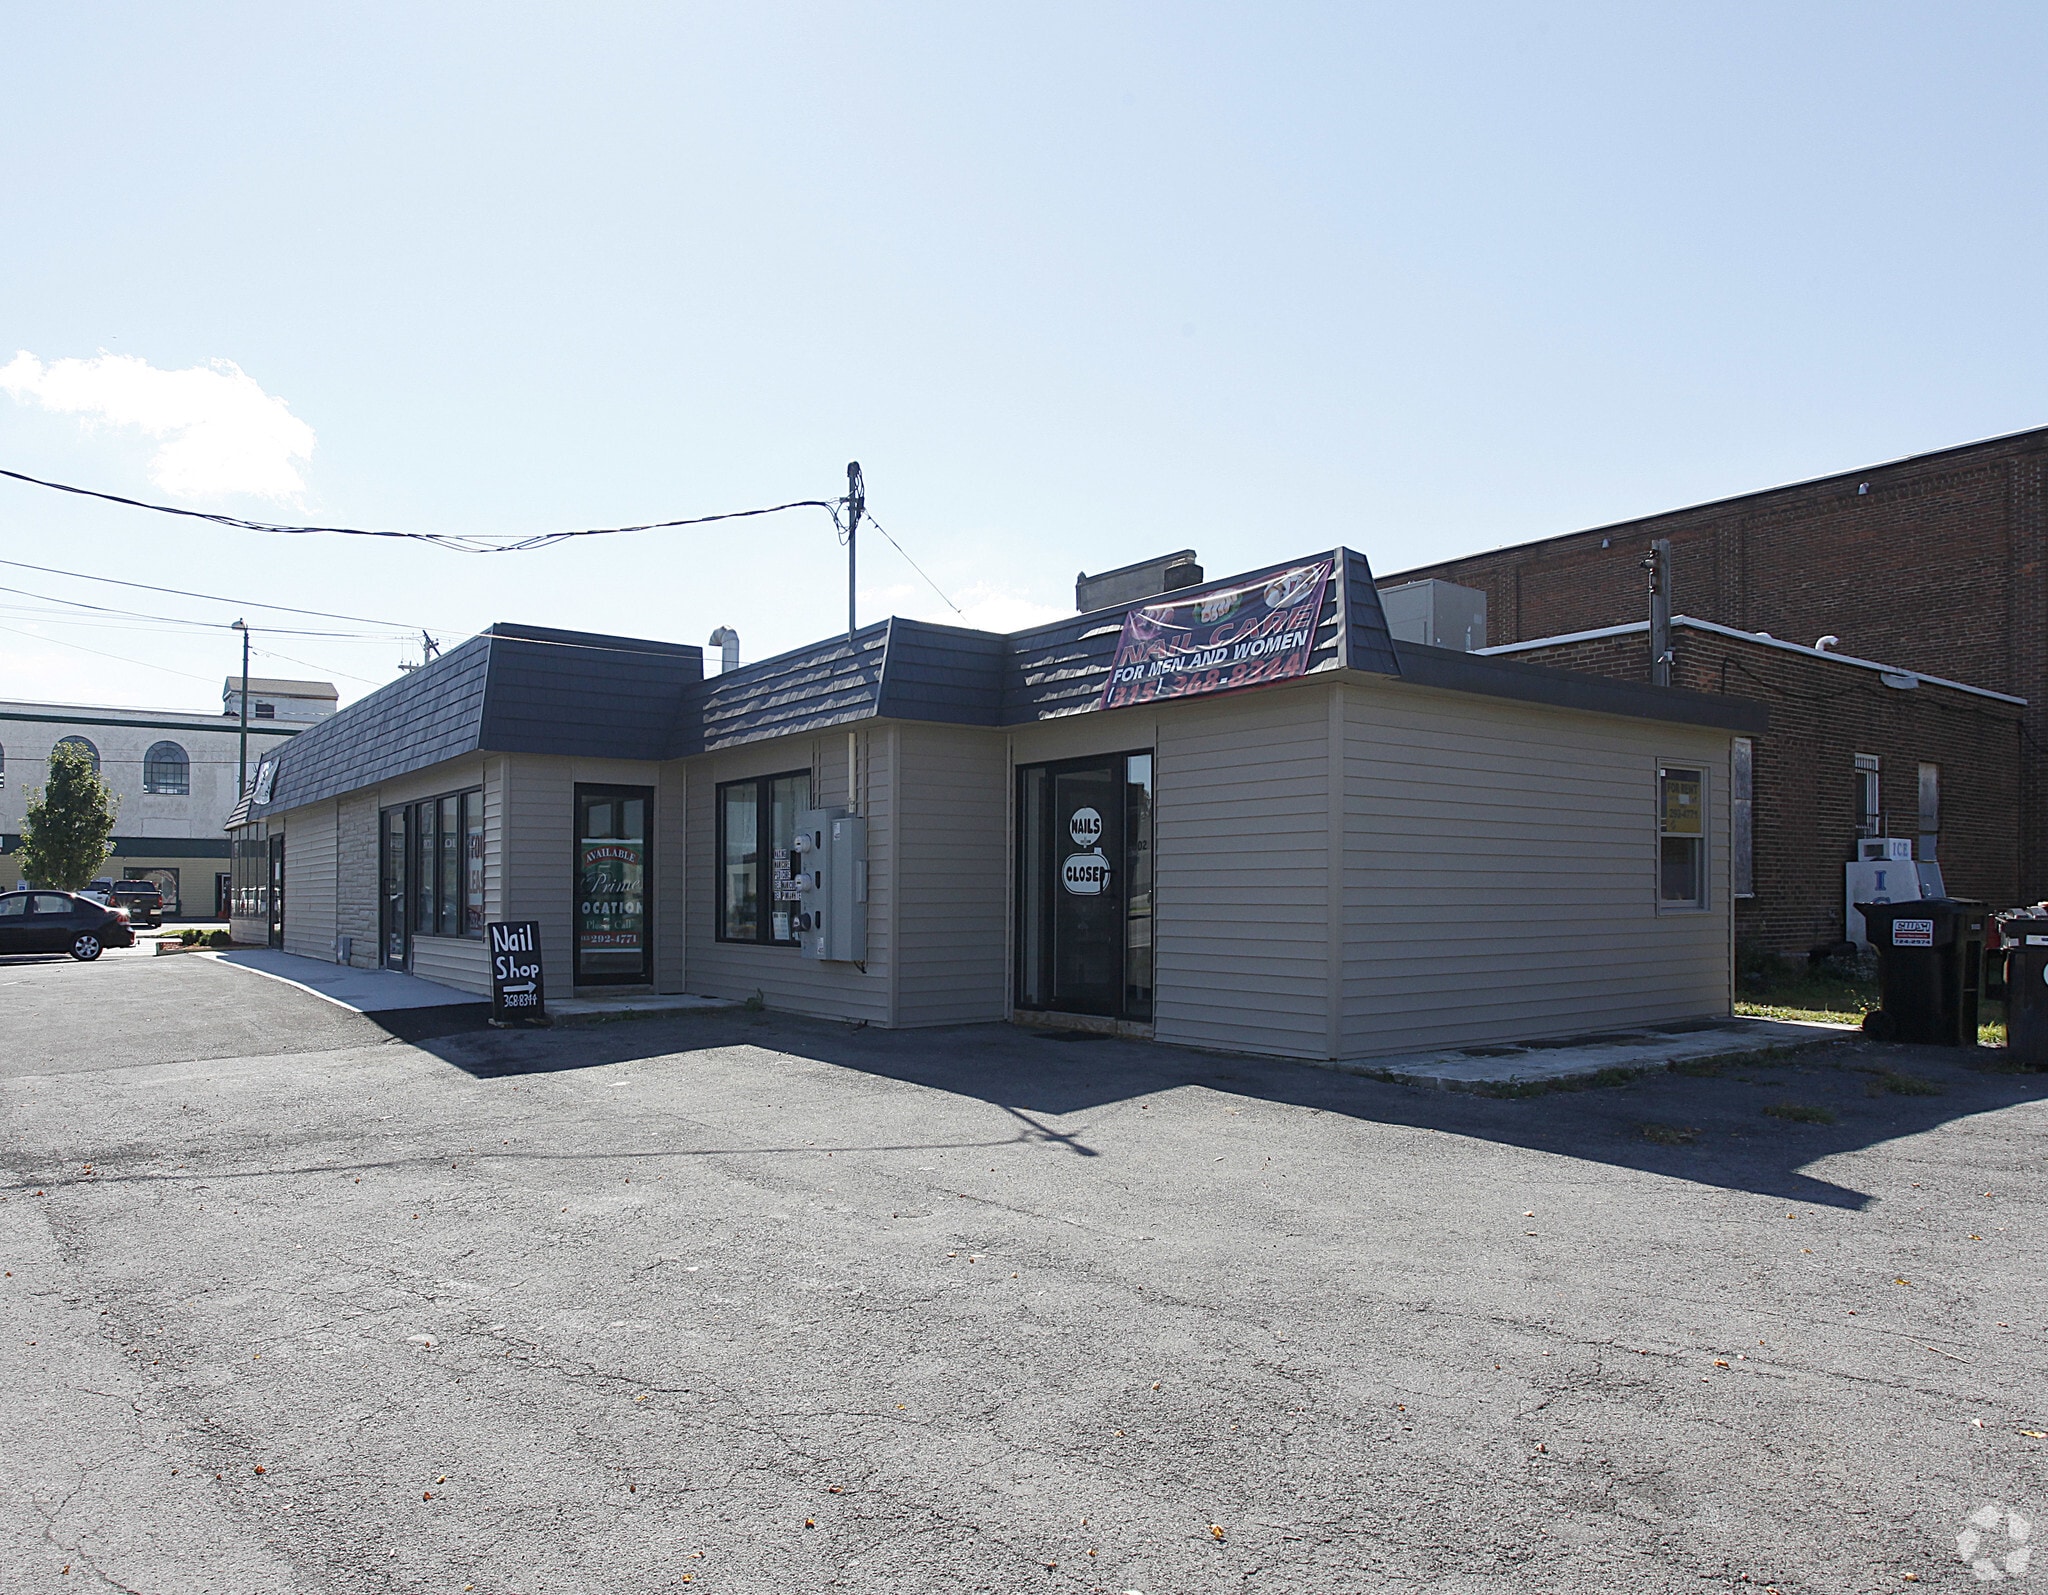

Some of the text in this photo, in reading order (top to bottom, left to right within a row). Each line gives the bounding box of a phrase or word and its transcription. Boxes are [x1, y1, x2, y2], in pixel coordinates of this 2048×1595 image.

[1119, 604, 1313, 666] NAIL CARE
[1112, 630, 1308, 684] FOR MEN AND WOMEN
[1107, 652, 1301, 709] (315) 368-8344
[1667, 782, 1698, 795] FOR RENT
[1071, 817, 1101, 835] NAILS
[586, 848, 636, 863] AVAILABLE
[1892, 841, 1908, 858] ICE
[581, 870, 641, 893] Prime
[492, 923, 533, 953] Nail
[591, 934, 637, 944] 292-4771
[495, 955, 539, 980] Shop
